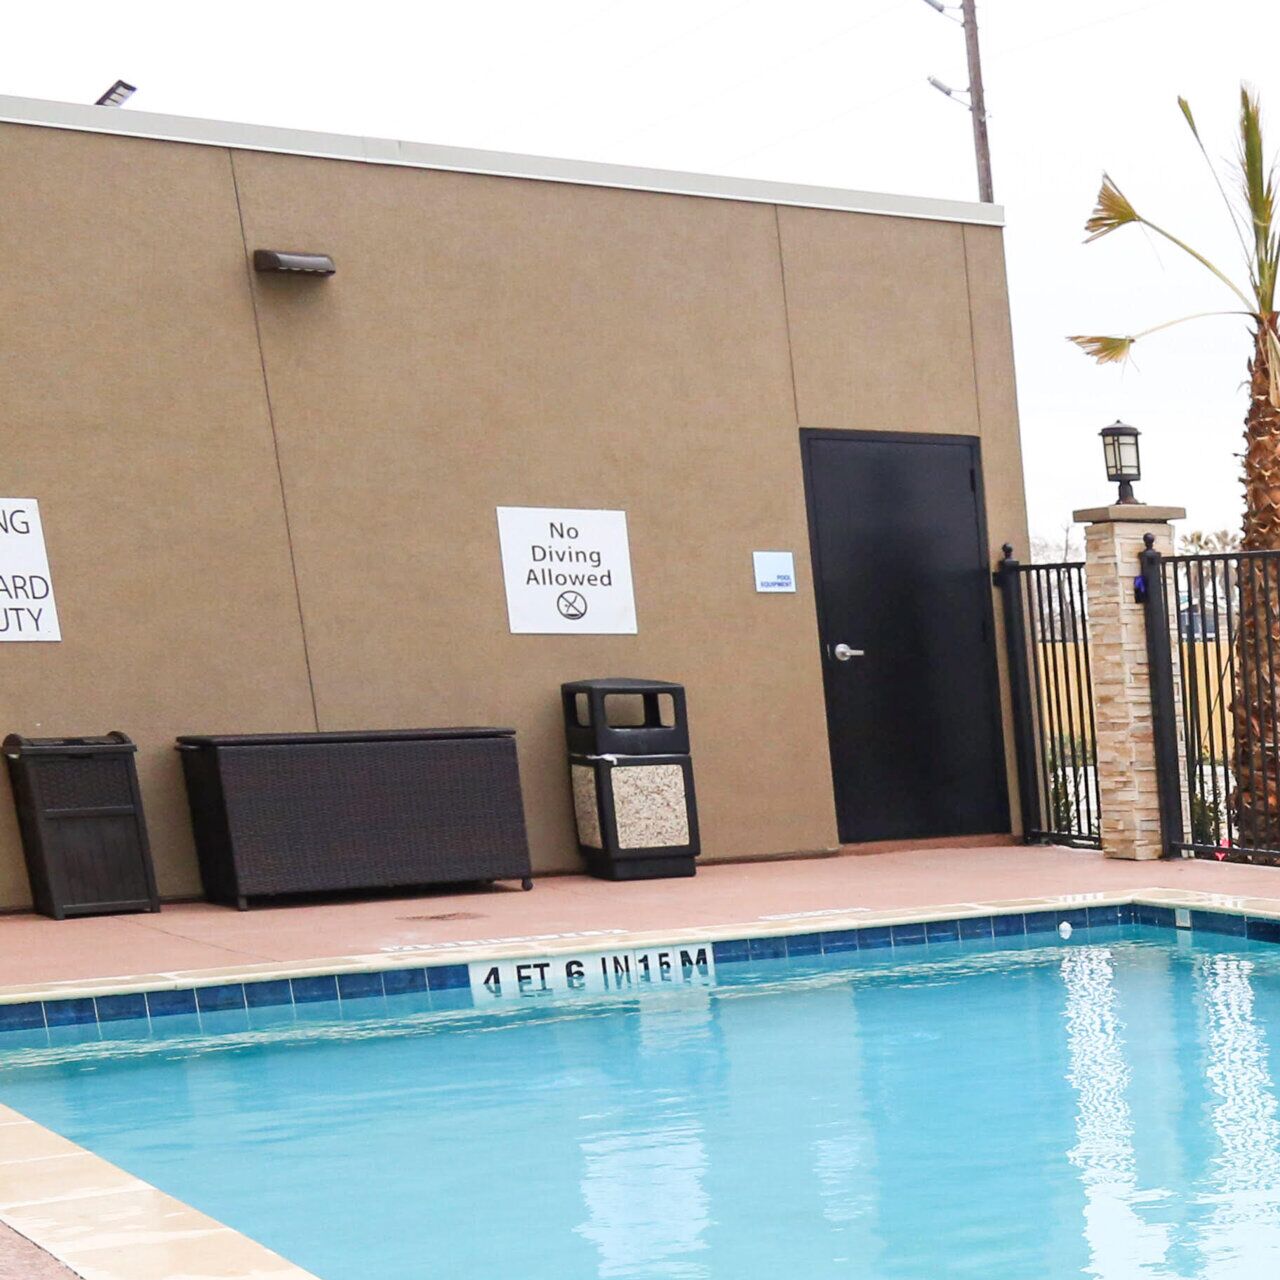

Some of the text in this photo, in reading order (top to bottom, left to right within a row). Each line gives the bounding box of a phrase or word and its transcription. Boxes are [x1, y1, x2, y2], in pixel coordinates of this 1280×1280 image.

[549, 522, 579, 540] No
[531, 545, 602, 568] Diving
[526, 568, 612, 587] Allowed
[516, 962, 550, 982] FT
